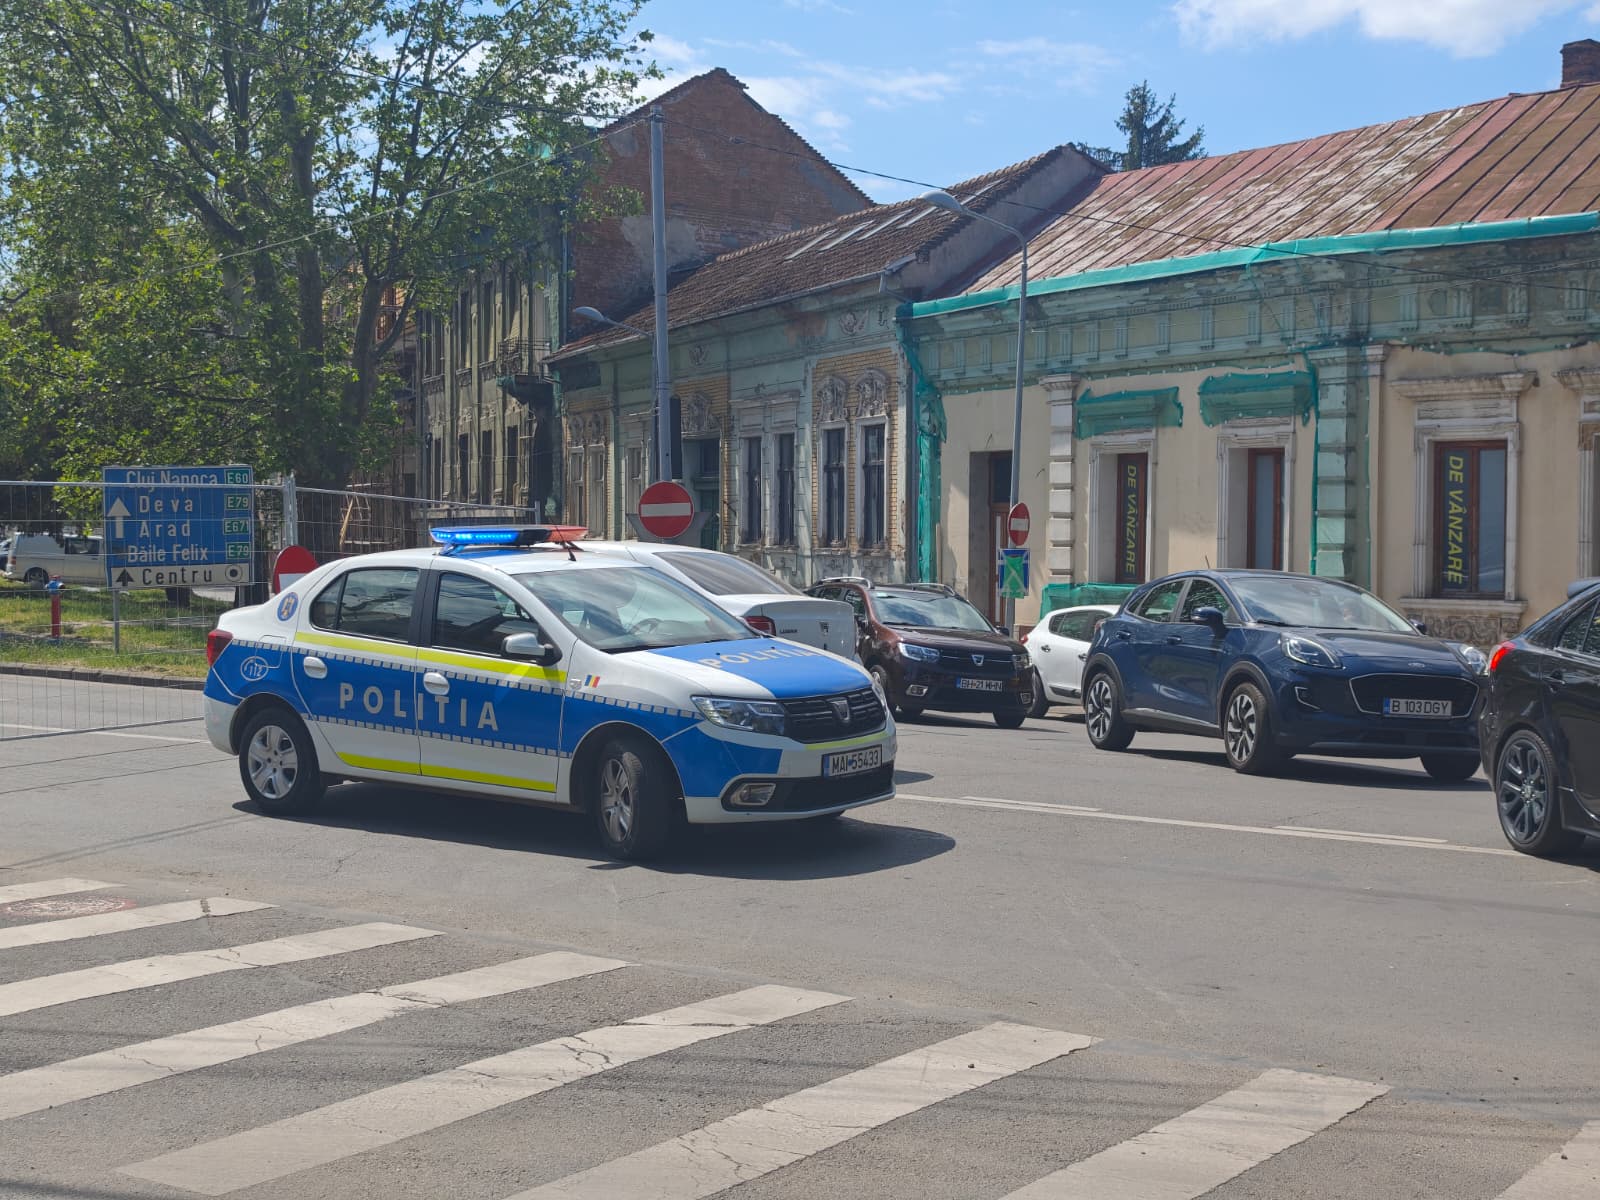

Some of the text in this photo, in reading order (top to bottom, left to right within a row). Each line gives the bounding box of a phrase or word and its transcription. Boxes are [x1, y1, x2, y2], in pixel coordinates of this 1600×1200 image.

[126, 470, 218, 492] Cluj Napoca
[227, 472, 249, 484] E60
[1127, 465, 1136, 489] DE
[139, 496, 193, 513] Deva
[227, 496, 249, 508] E79
[139, 520, 191, 537] Arad
[224, 521, 249, 533] E671
[1447, 456, 1467, 584] DE VÂNZARE
[172, 543, 208, 561] Felix
[228, 545, 249, 557] E79
[142, 567, 212, 585] Centru
[339, 682, 499, 731] POLITIA
[1392, 700, 1400, 712] B
[832, 750, 879, 773] MAI 55433
